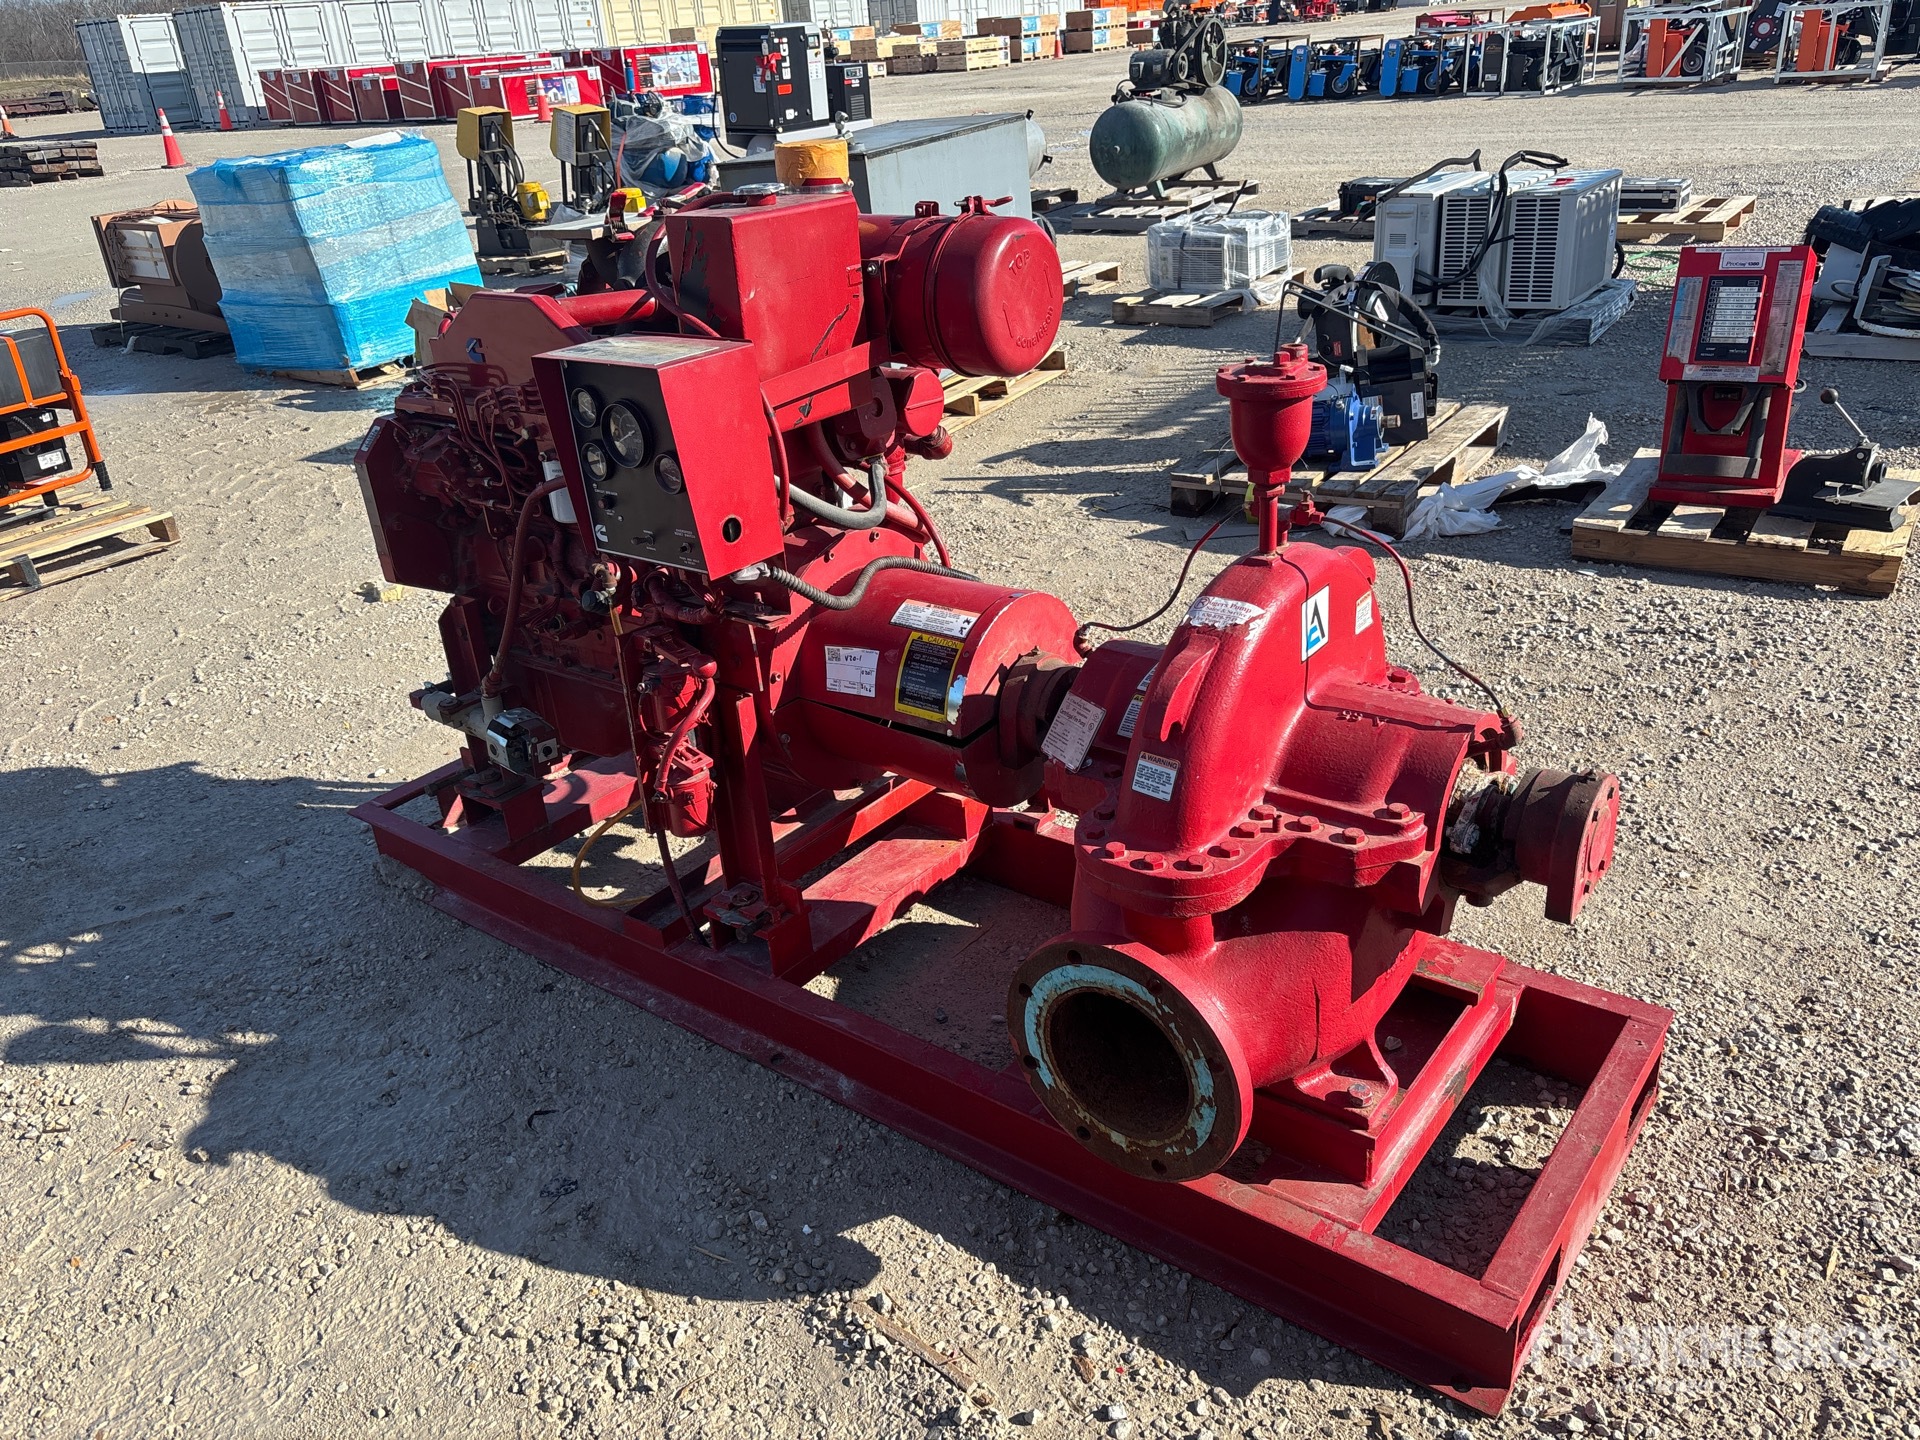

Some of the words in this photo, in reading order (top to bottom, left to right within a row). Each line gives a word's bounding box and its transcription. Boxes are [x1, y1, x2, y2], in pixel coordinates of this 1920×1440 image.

[1009, 249, 1030, 276] TOP
[1230, 603, 1252, 614] Pump
[927, 636, 959, 648] CAUTION
[1147, 755, 1178, 770] WARNING
